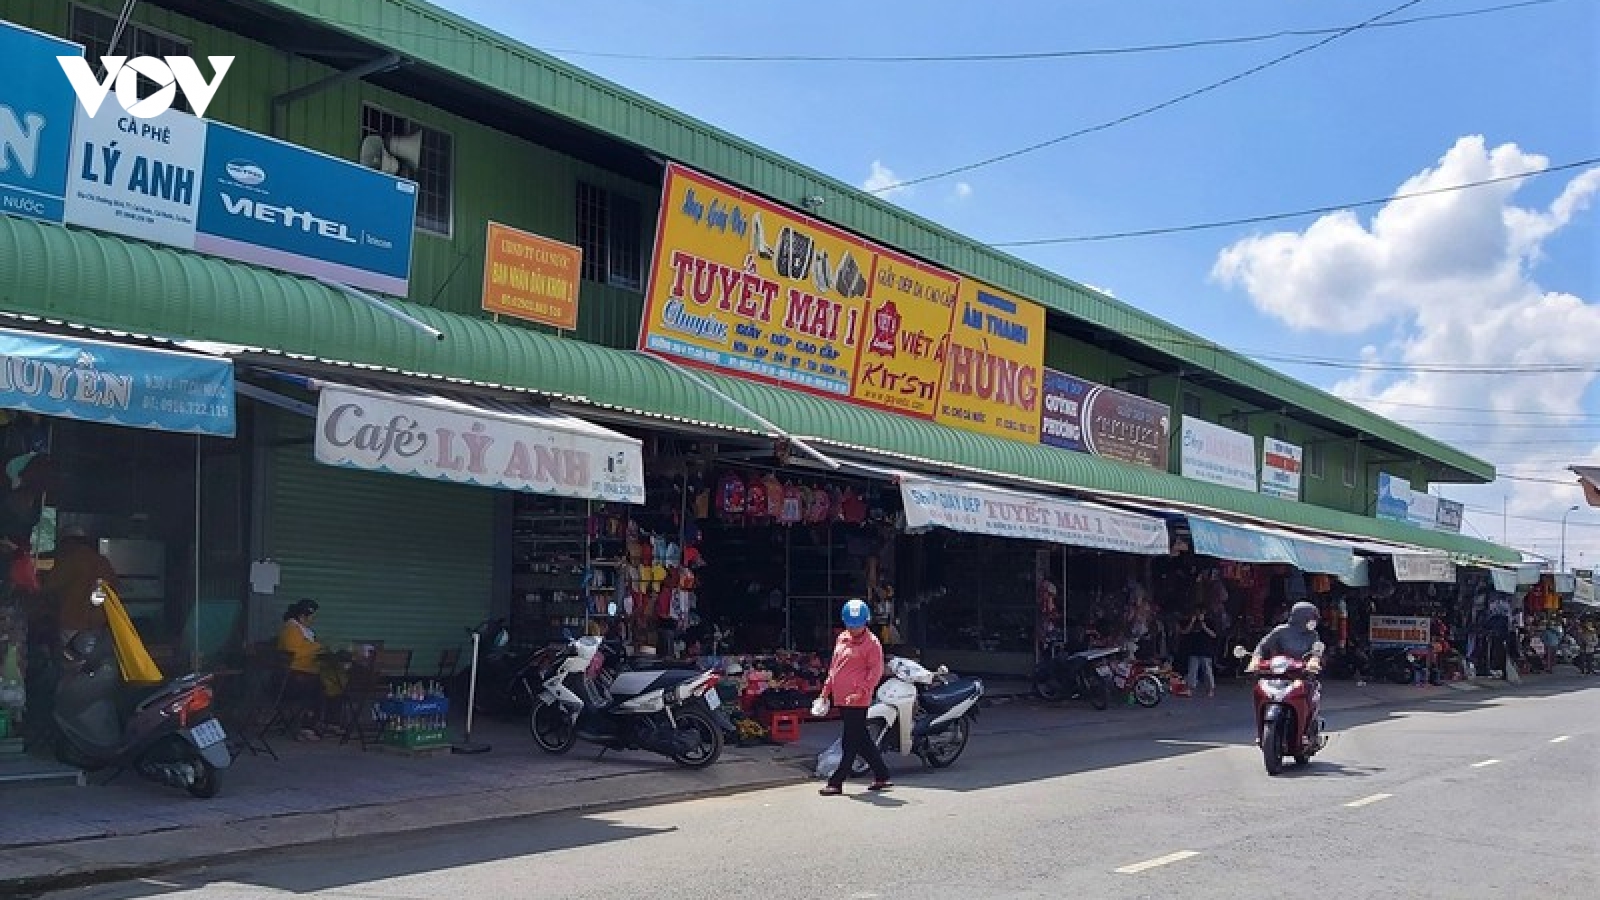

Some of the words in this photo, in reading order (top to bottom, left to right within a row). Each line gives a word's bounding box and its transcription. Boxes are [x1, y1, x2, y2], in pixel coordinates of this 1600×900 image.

[118, 116, 138, 136] CÀ
[141, 122, 171, 145] PHÊ
[82, 141, 121, 187] LÝ
[128, 155, 195, 205] ANH
[671, 250, 780, 324] TUYẾT
[783, 288, 843, 341] MAI
[844, 308, 858, 346] 1
[901, 329, 934, 360] VIỆT
[949, 338, 1037, 411] HÙNG
[324, 402, 428, 461] Café
[503, 440, 591, 487] ANH
[984, 500, 1050, 526] TUYẾT
[1054, 511, 1091, 531] MAI
